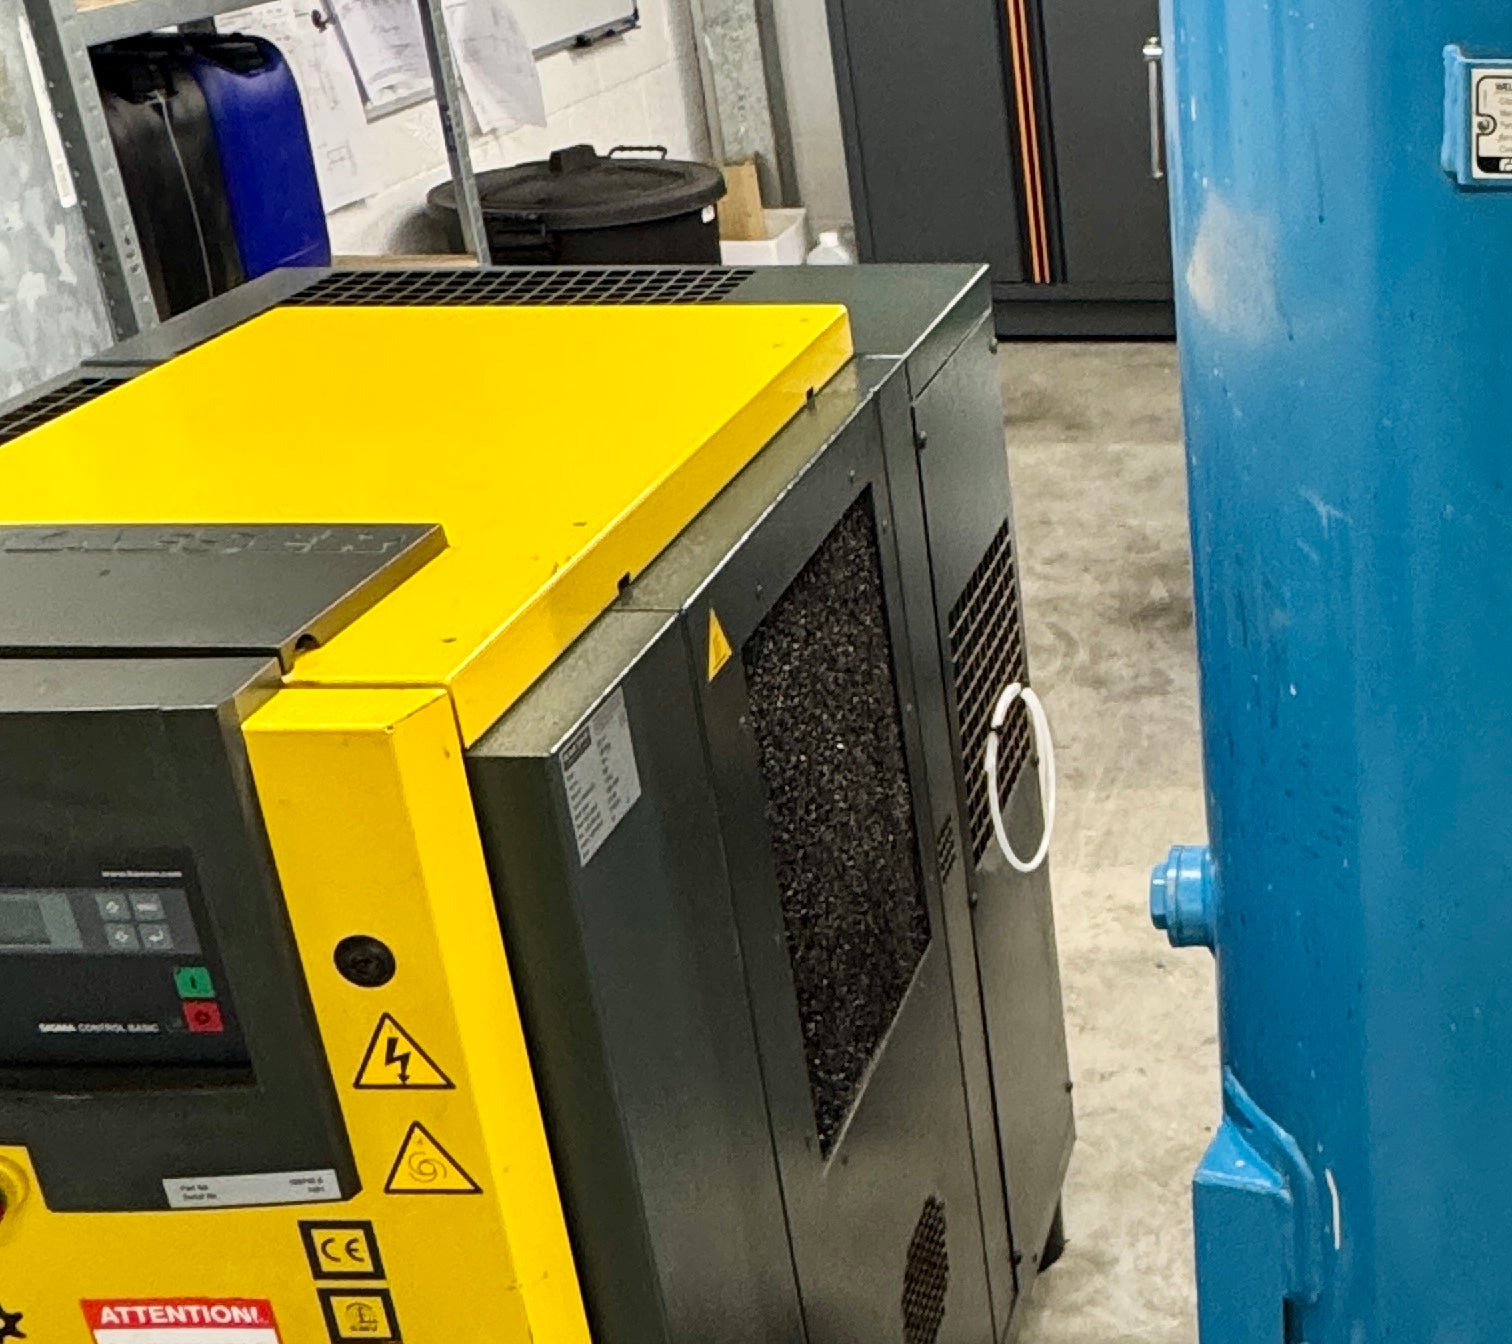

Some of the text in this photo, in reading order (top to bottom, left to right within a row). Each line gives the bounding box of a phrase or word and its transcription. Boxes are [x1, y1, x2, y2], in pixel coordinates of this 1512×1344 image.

[77, 1022, 127, 1034] CONTROL
[126, 1023, 160, 1034] BASIC
[321, 1237, 366, 1264] CE
[100, 1304, 260, 1326] ATTENTION!
